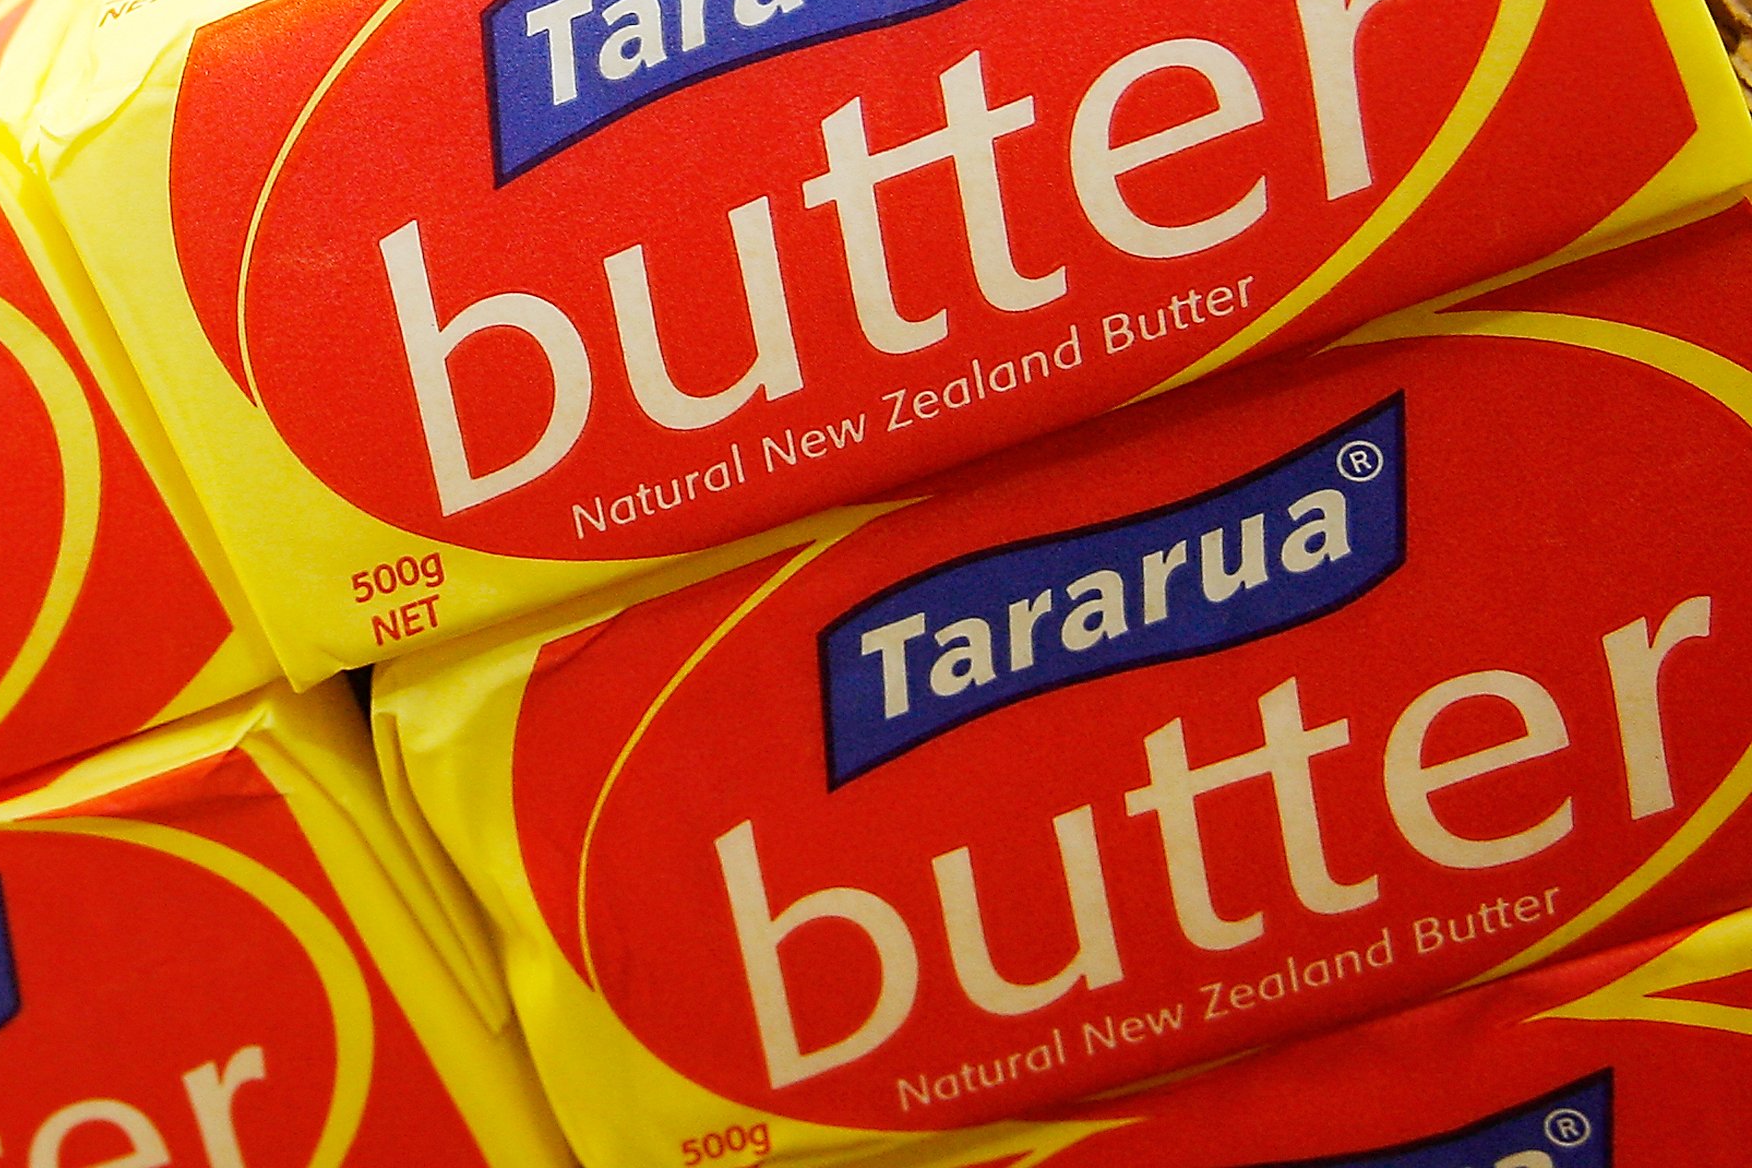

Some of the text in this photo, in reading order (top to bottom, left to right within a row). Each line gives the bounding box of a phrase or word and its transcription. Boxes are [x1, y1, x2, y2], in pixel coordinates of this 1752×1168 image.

[570, 273, 1255, 540] Natural New Zealand Butter
[348, 551, 446, 605] 500g
[371, 595, 443, 648] NET
[714, 595, 1713, 1091] butter
[895, 884, 1561, 1114] Natural New Zealand Butter
[680, 1120, 773, 1167] 500g
